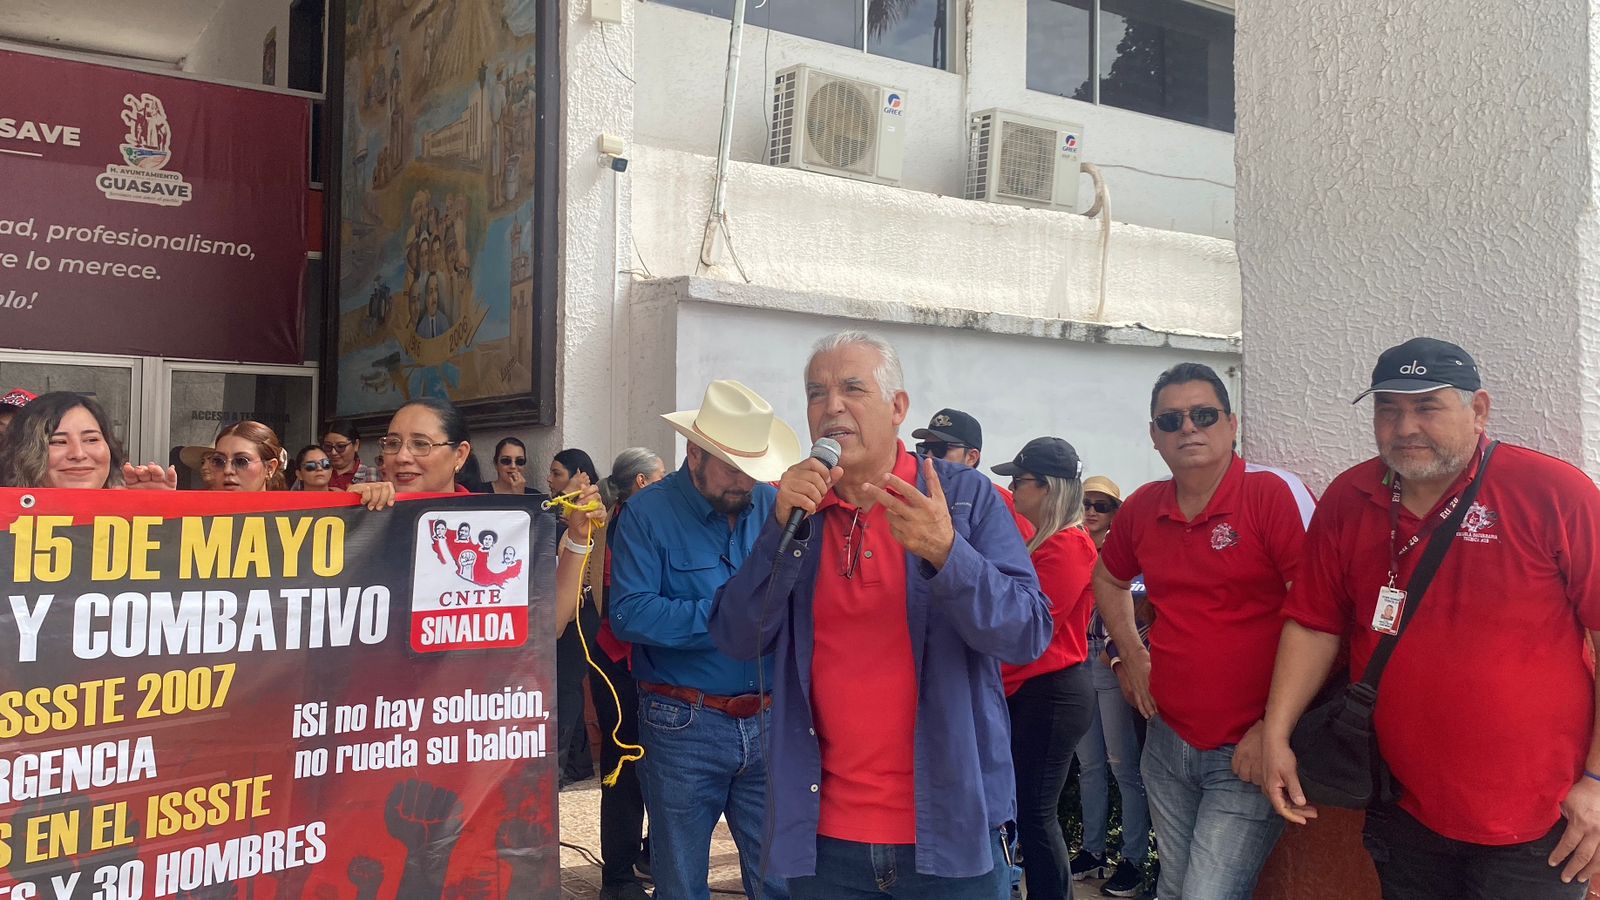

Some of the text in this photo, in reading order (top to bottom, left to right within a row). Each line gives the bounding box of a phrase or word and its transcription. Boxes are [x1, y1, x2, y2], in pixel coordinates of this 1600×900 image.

[0, 118, 80, 146] SAVE
[100, 176, 188, 197] GUASAVE
[120, 168, 179, 180] AYUNTAMIENTO
[46, 224, 256, 260] profesionalismo,
[26, 251, 50, 270] lo
[58, 258, 161, 280] merece.
[1400, 360, 1427, 375] alo
[9, 516, 345, 582] 15 DE MAYO
[439, 589, 502, 606] CNTE
[8, 585, 390, 662] Y COMBATIVO
[420, 612, 515, 646] SINALOA
[0, 663, 236, 738] SSSTE 2007
[334, 702, 367, 734] no
[374, 696, 424, 732] hay
[432, 686, 550, 724] solución,
[294, 724, 546, 779] no rueda su balón!
[25, 810, 80, 863] EN
[91, 802, 134, 851] EL
[146, 774, 273, 840] ISSSTE
[51, 872, 81, 900] Y
[93, 859, 144, 900] 30
[155, 821, 326, 898] HOMBRES
